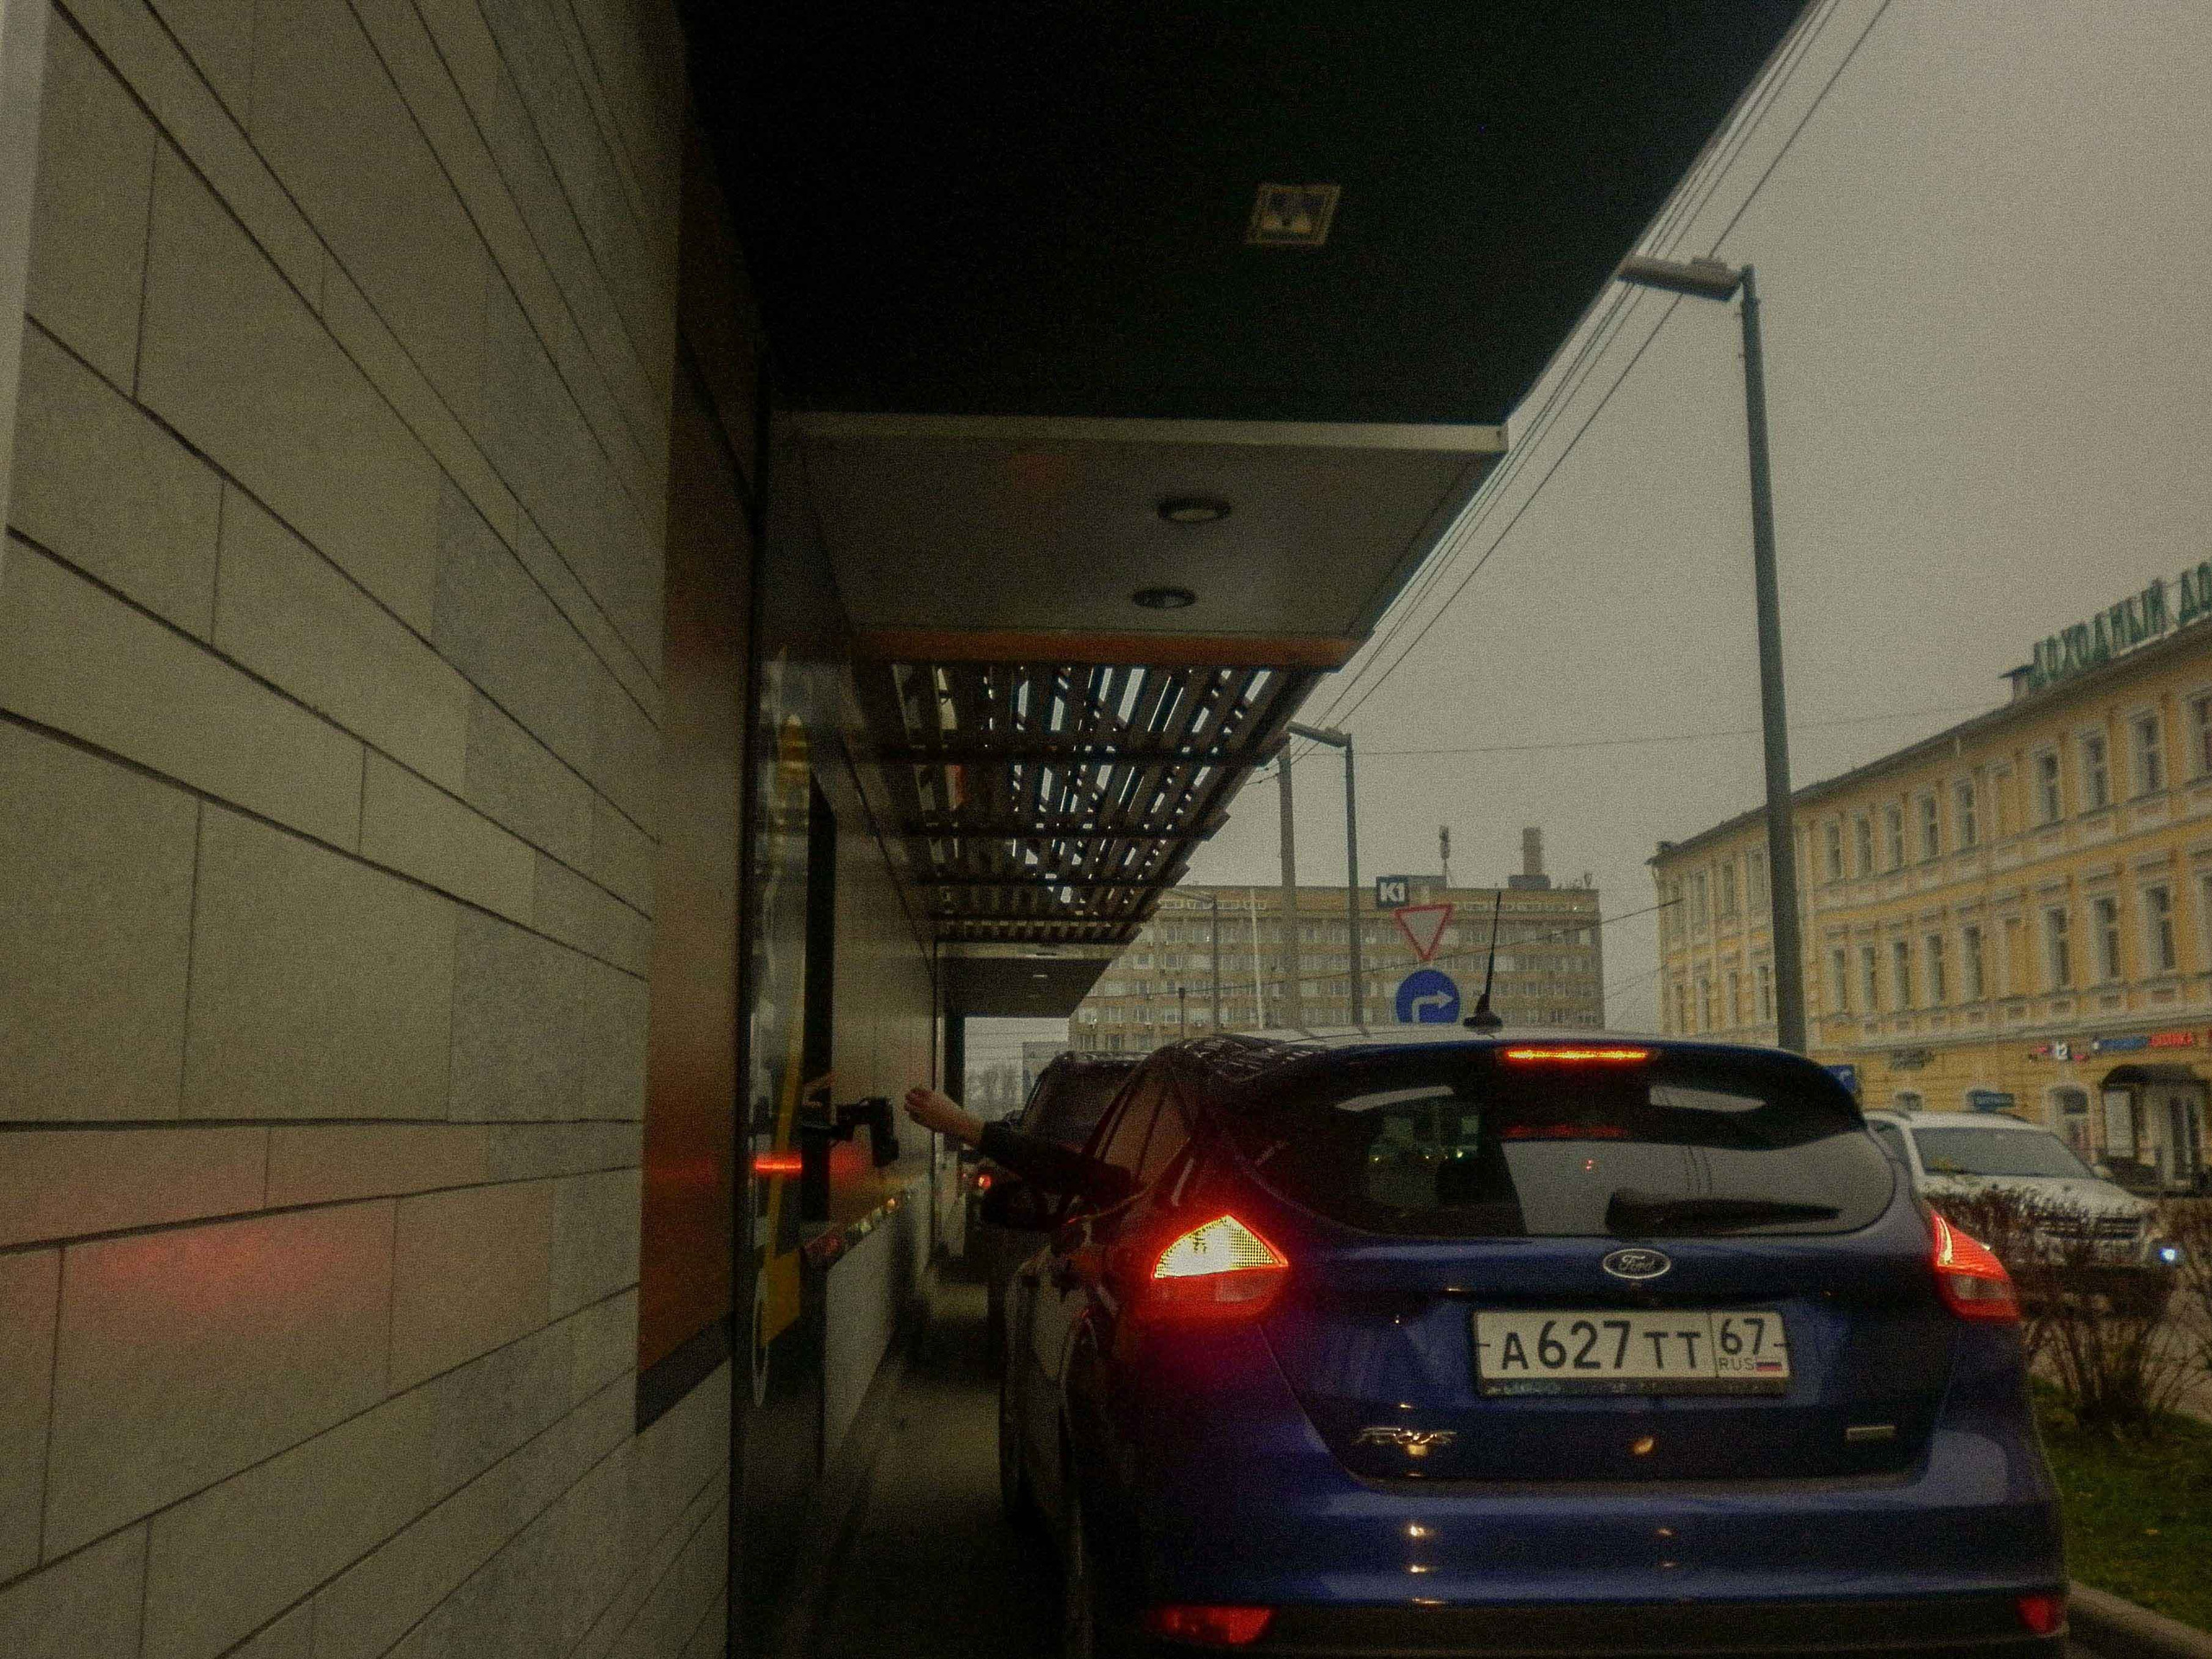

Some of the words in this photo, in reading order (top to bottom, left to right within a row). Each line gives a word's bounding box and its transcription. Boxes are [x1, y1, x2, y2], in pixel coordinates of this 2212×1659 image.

[1618, 1255, 1656, 1271] Ford
[1719, 1318, 1765, 1356] 67
[1719, 1357, 1754, 1370] RUS
